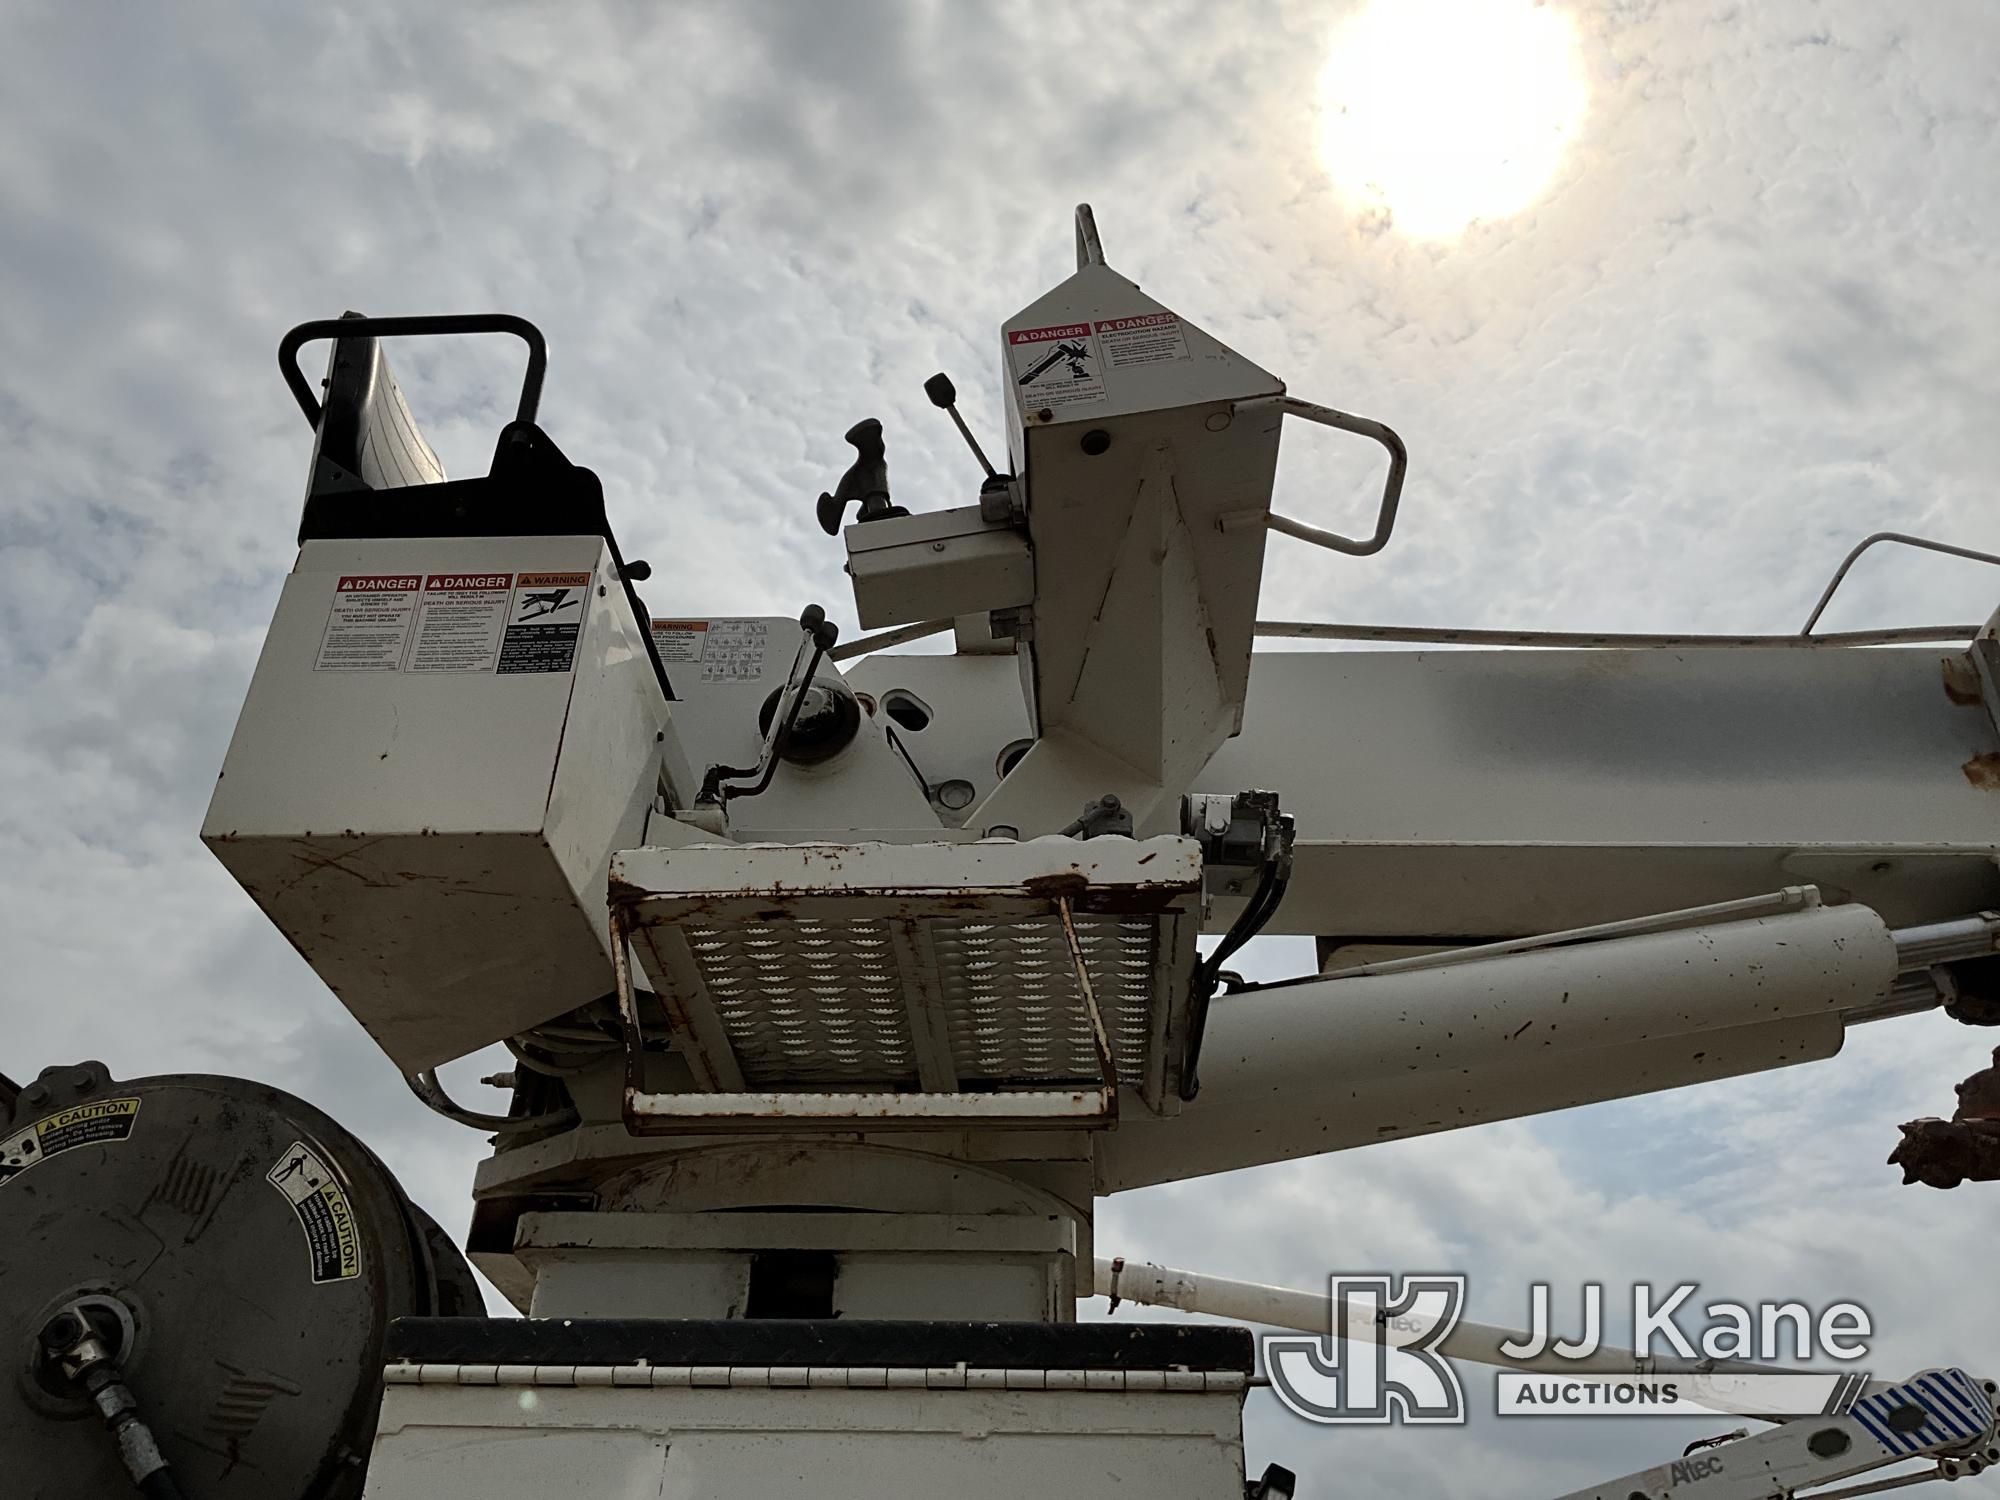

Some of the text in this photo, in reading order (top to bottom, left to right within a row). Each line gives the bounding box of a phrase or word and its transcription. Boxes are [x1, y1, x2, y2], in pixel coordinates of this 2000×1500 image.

[1116, 314, 1176, 329] DANGER
[1030, 327, 1083, 341] DANGER
[355, 579, 417, 589] DANGER
[444, 577, 506, 588] DANGER
[534, 575, 585, 585] WARNING
[59, 1102, 130, 1125] CAUTION
[331, 1201, 355, 1269] CAUTION
[1670, 1456, 1724, 1487] Altec
